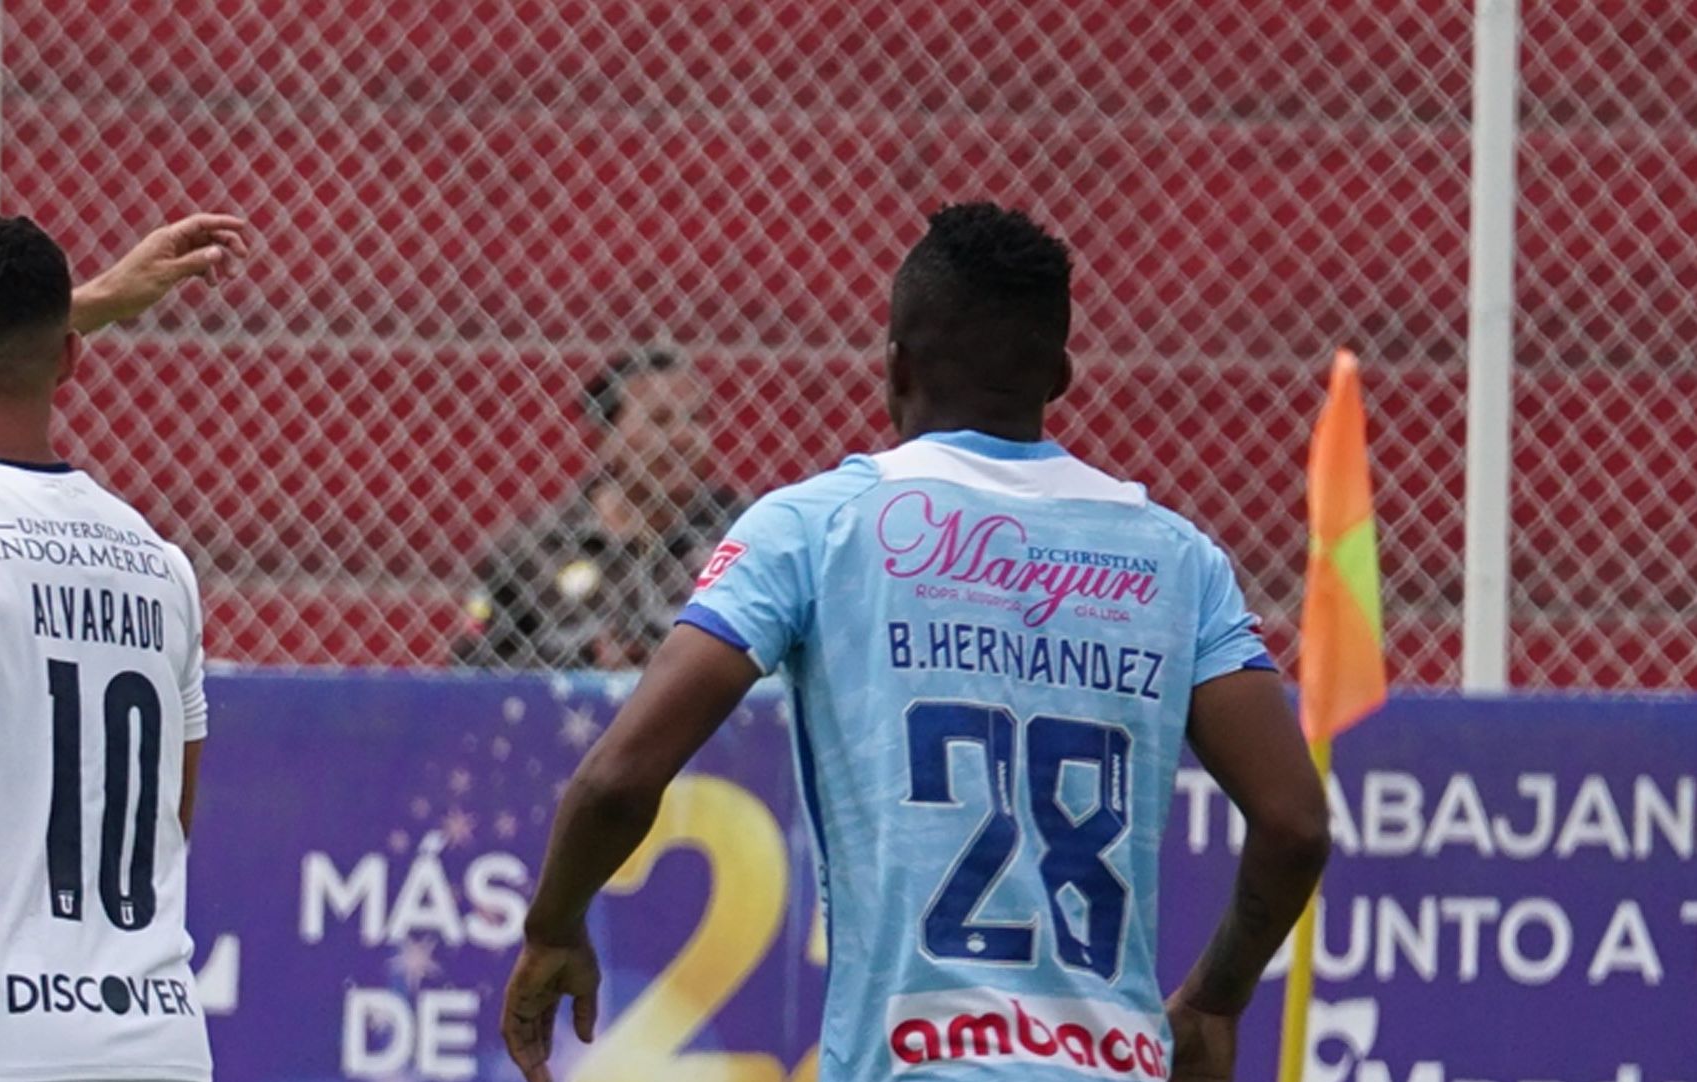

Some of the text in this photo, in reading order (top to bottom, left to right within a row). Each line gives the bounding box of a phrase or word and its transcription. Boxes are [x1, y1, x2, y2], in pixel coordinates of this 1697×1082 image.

[17, 517, 142, 547] UNIVERSIDAD
[877, 490, 1159, 628] Maryuri
[1027, 546, 1159, 574] D'CHRISTIAN
[32, 582, 164, 652] ALVARADO
[888, 621, 1164, 701] B.HERNANDEZ
[46, 658, 161, 933] 10
[902, 699, 1134, 986] 28
[299, 833, 531, 947] MÁS
[1260, 894, 1664, 986] UNTO A
[6, 973, 195, 1017] DISCOVER
[341, 984, 480, 1082] DE
